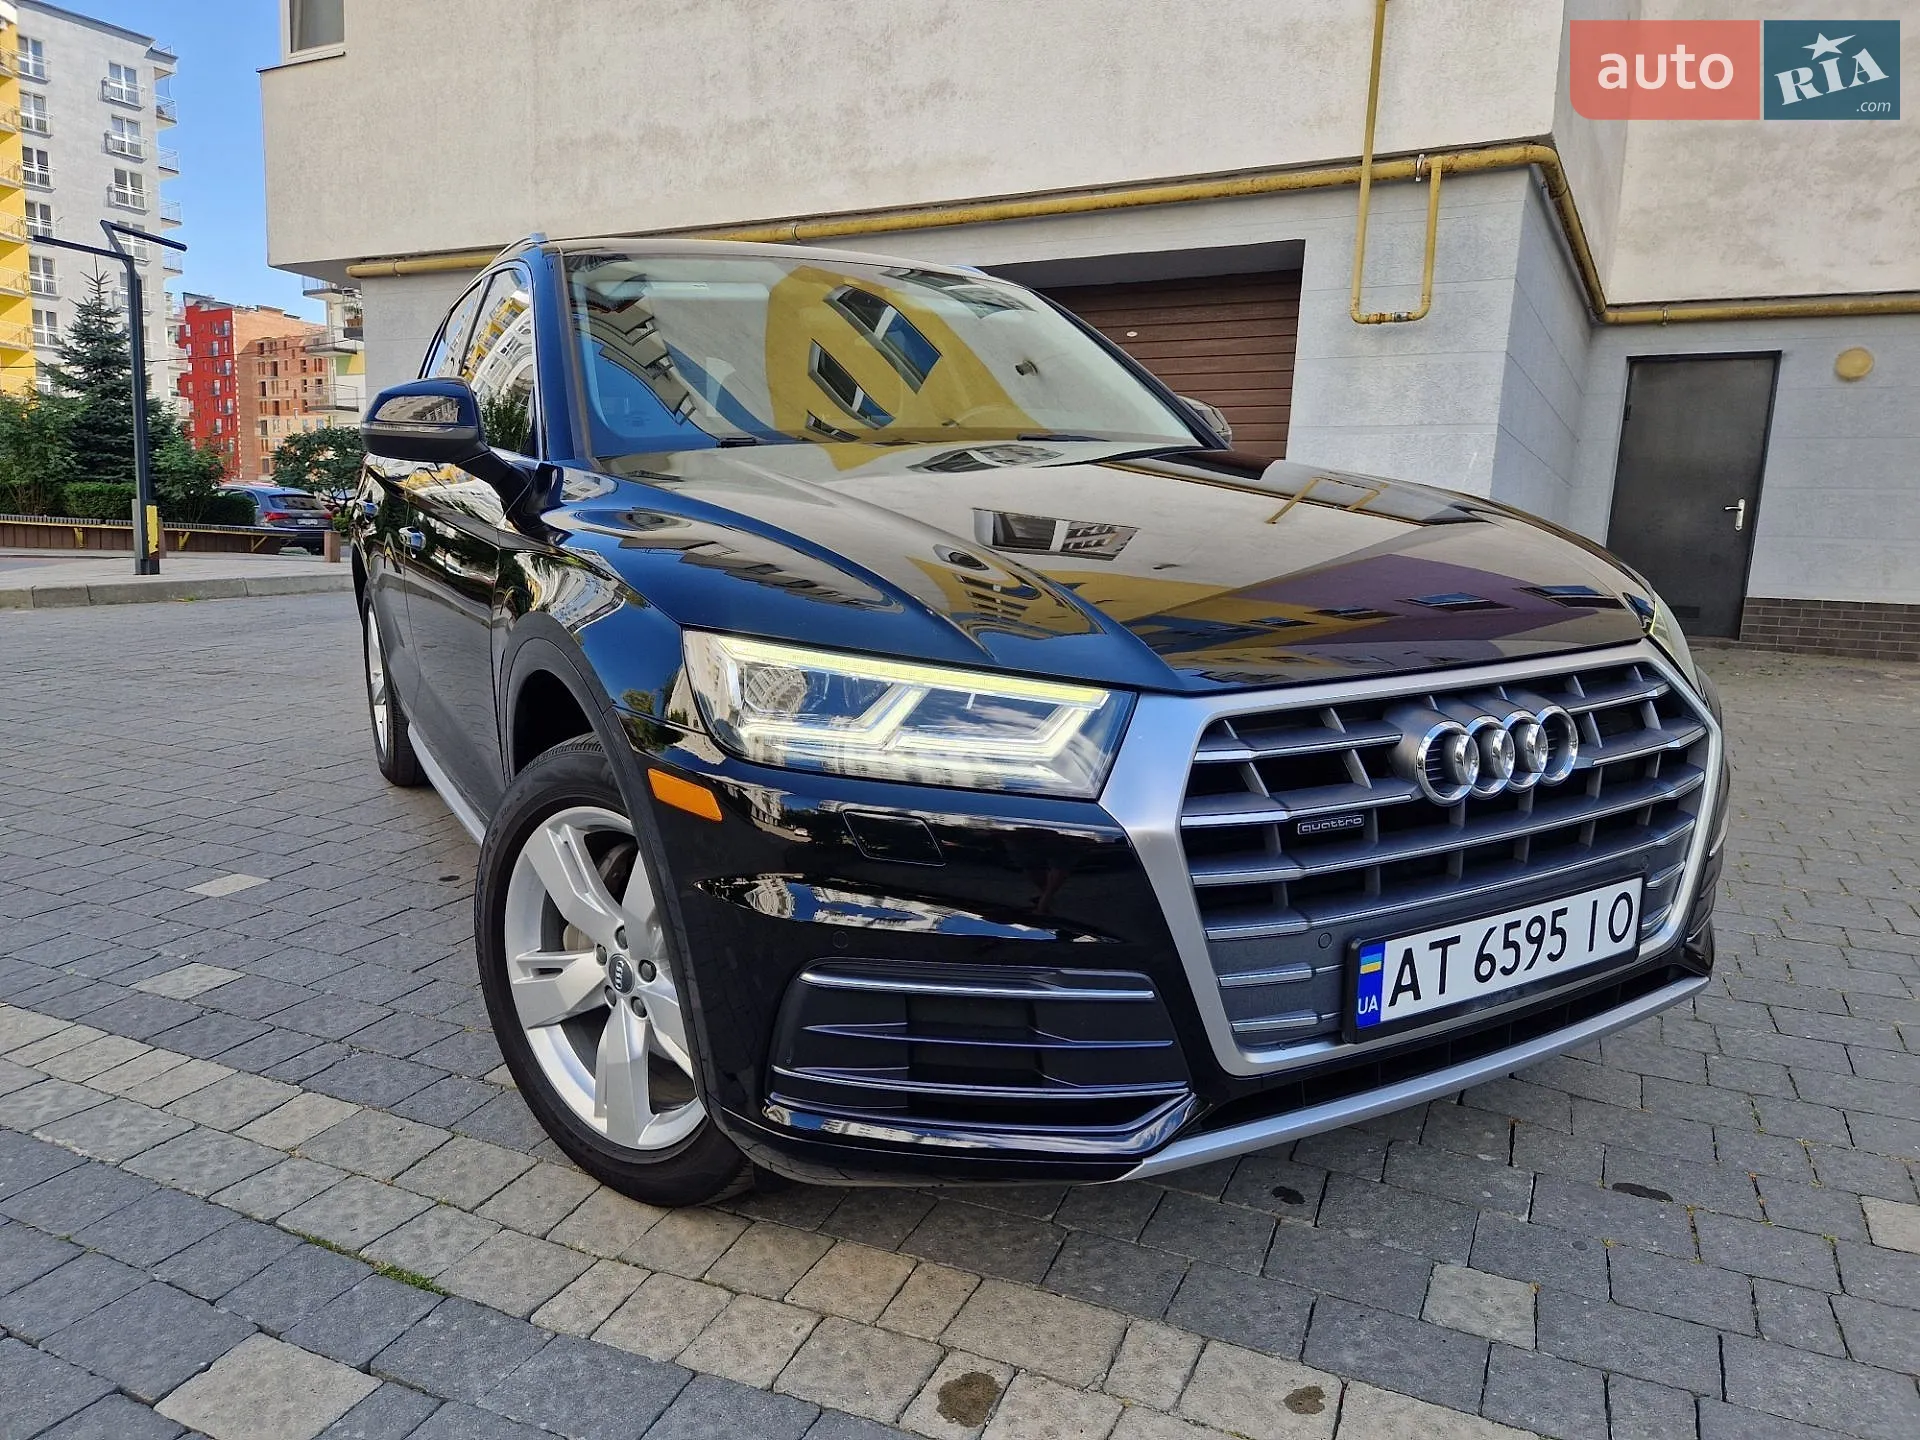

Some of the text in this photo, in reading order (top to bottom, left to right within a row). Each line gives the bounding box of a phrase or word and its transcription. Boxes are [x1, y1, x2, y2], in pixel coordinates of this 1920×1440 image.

[1302, 817, 1362, 832] quattro
[1388, 935, 1461, 1007] AT
[1474, 907, 1568, 984] 6595
[1358, 994, 1379, 1014] UA
